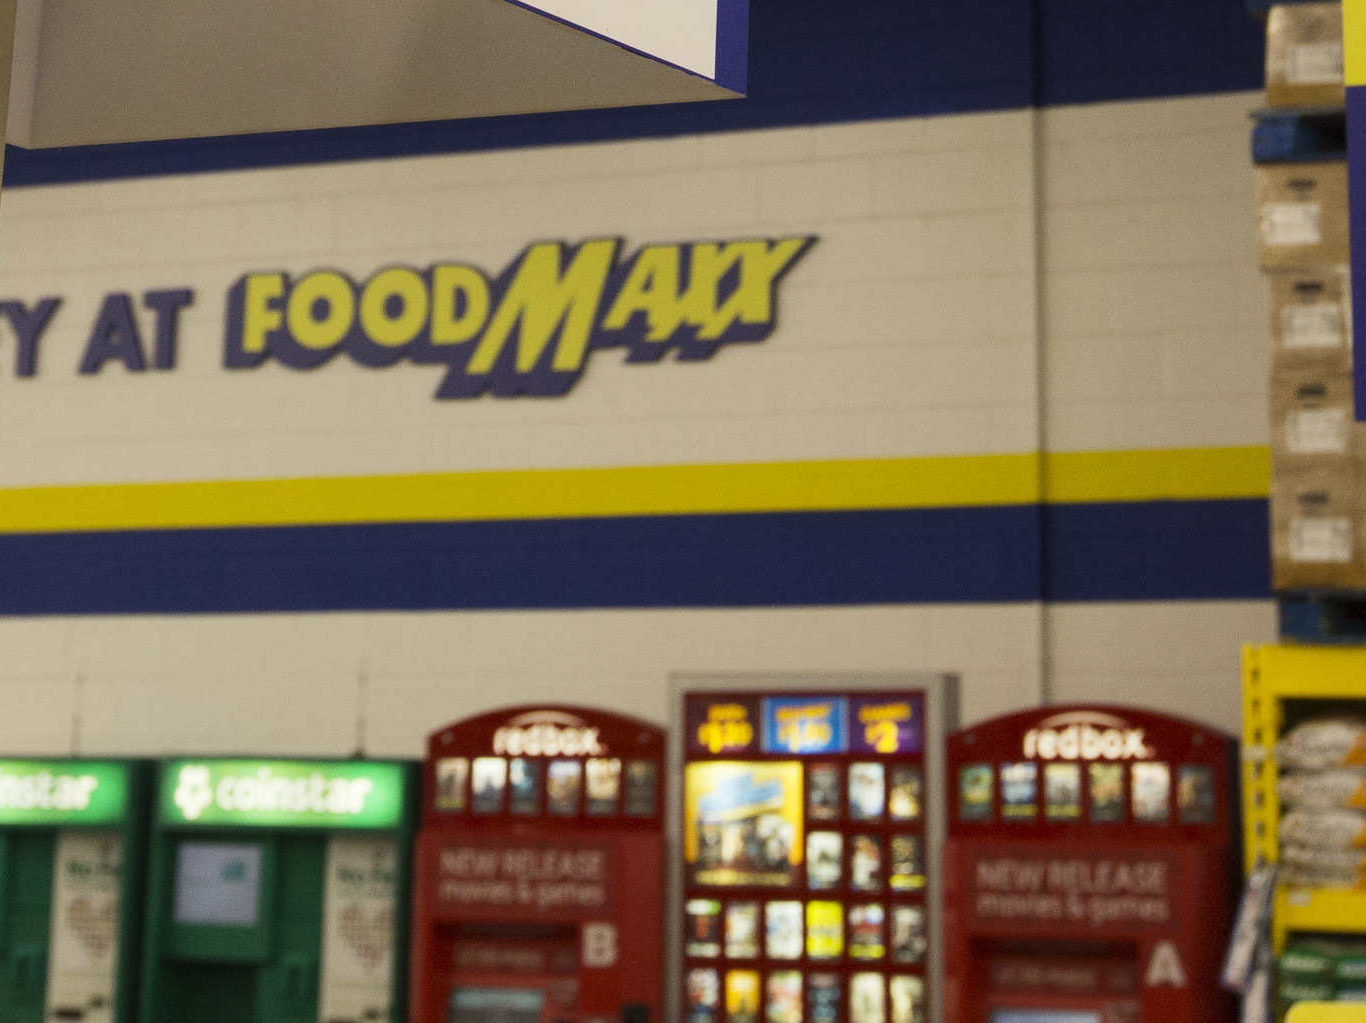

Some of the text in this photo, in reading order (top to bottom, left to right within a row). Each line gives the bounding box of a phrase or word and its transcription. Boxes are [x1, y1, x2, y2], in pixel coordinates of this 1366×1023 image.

[78, 288, 195, 374] AT
[225, 235, 818, 401] FOODMAXX
[216, 767, 373, 815] coinstar
[439, 848, 604, 878] NEW RELEASE
[976, 860, 1166, 892] NEW RELEASE
[582, 922, 618, 968] B
[1146, 942, 1186, 987] A
